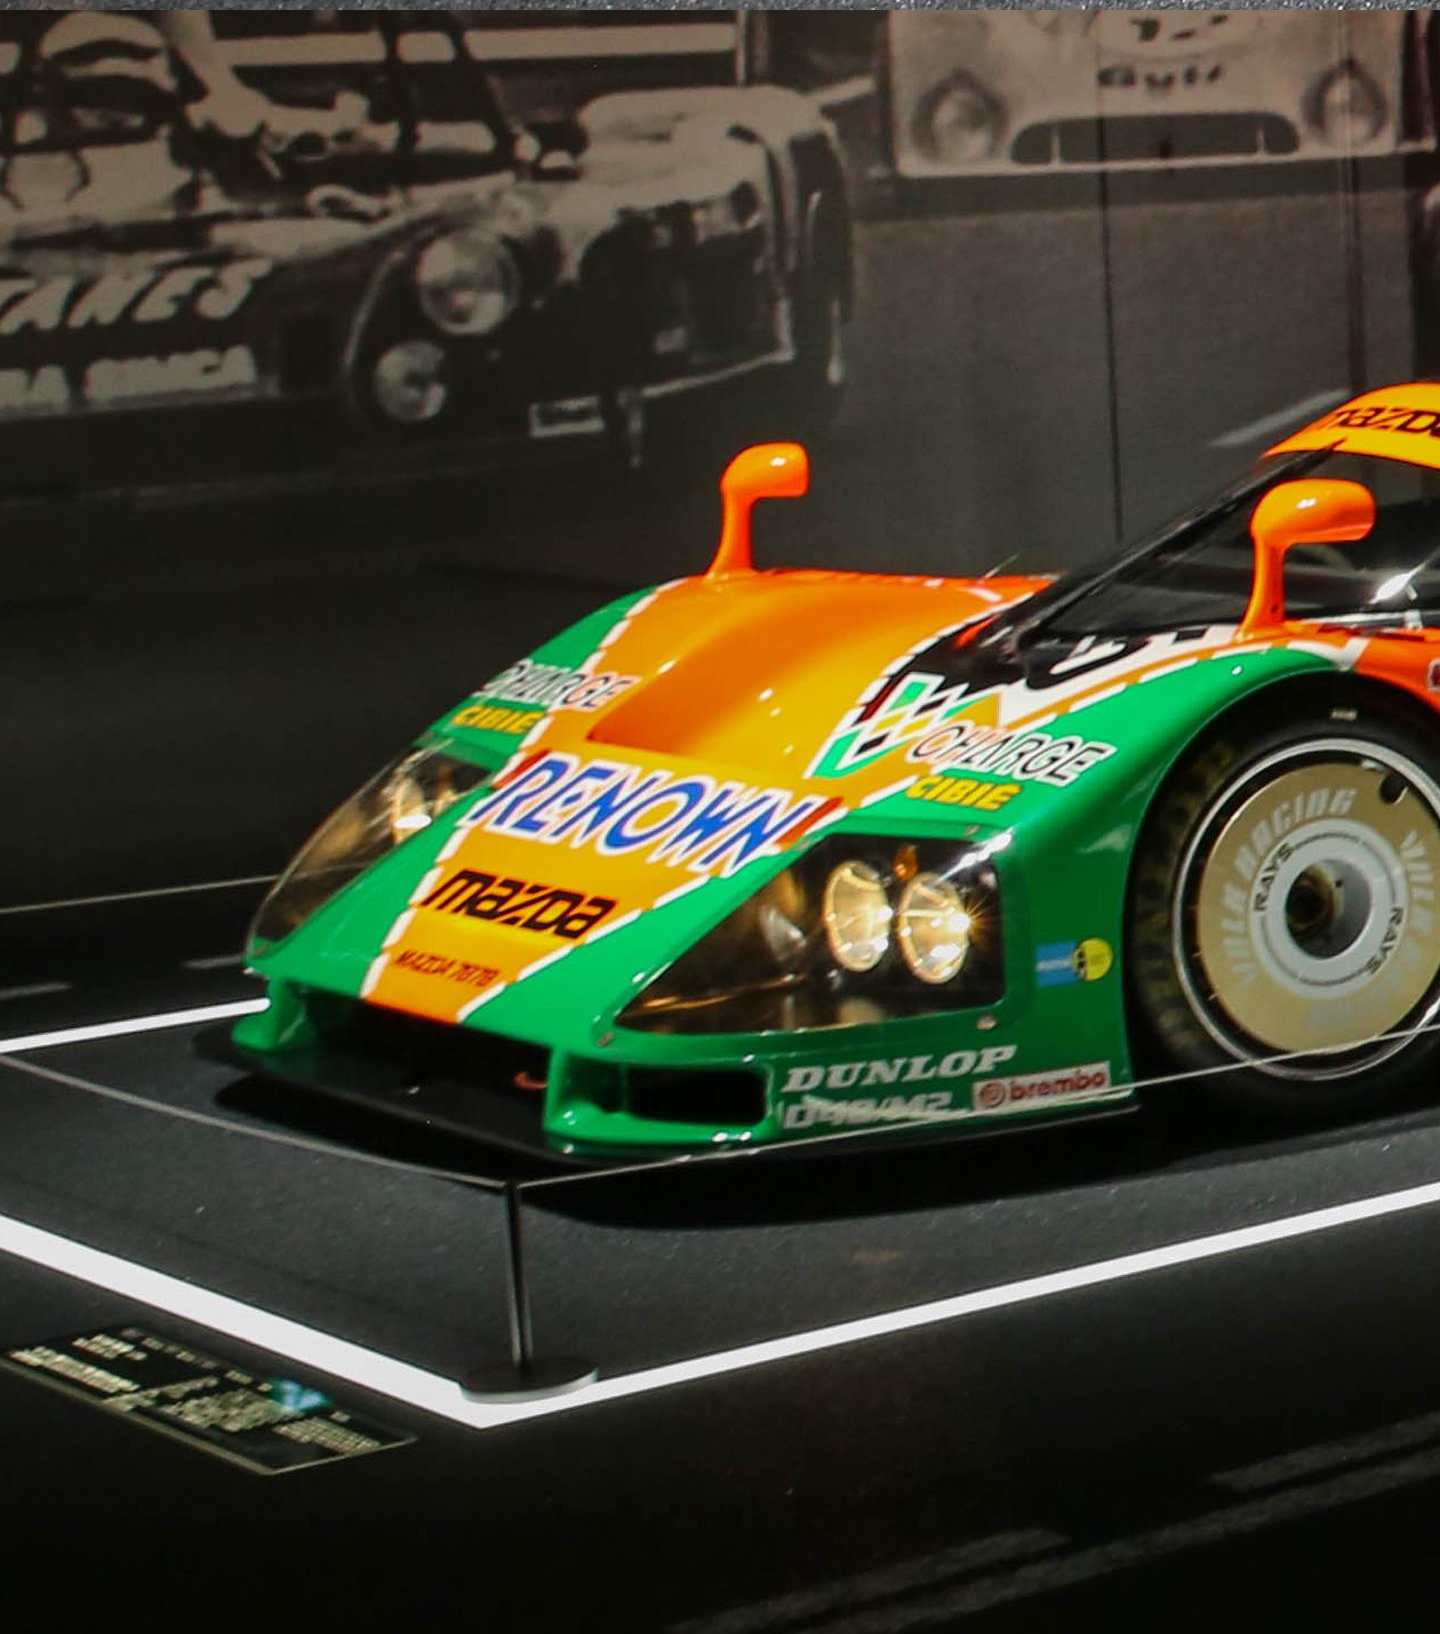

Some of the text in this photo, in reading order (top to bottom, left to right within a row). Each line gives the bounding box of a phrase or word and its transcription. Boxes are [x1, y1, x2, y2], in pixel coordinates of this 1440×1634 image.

[483, 659, 640, 713] CHARGE
[905, 720, 1119, 787] CHARGE
[461, 747, 826, 878] RENOWN
[1253, 842, 1296, 912] RAYS
[781, 1044, 1018, 1093] DUNLOP
[1010, 1067, 1106, 1100] brembo
